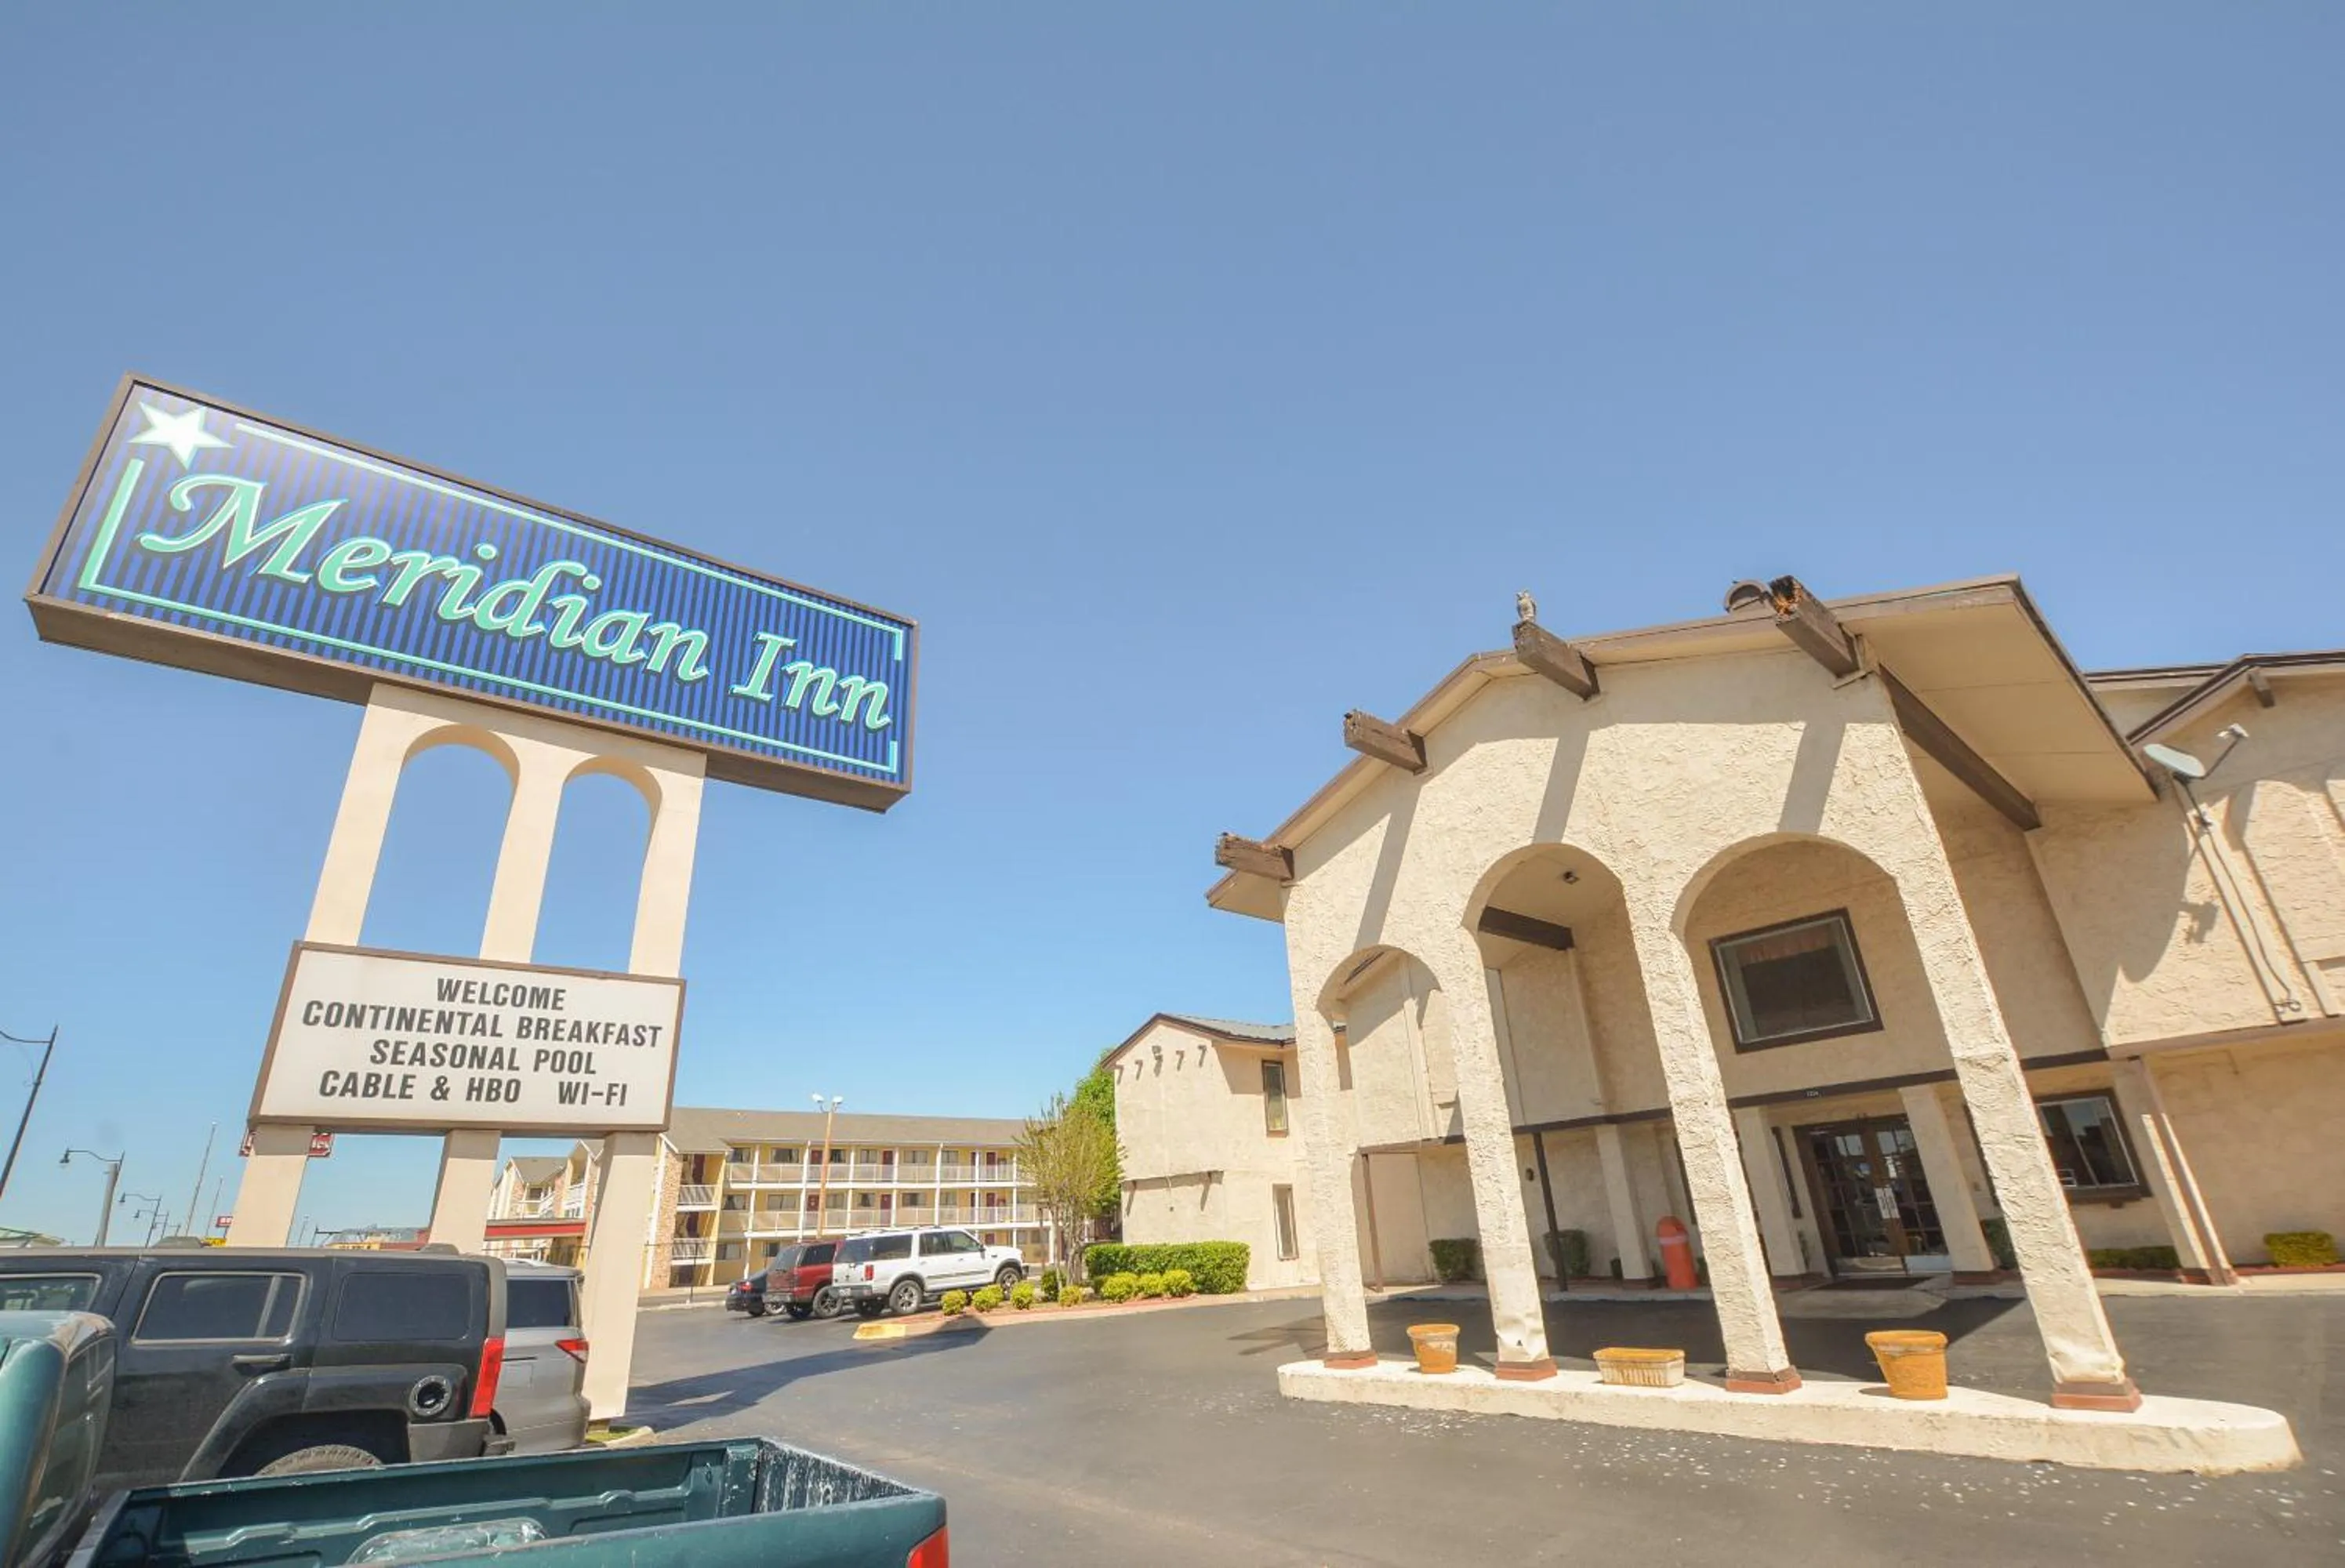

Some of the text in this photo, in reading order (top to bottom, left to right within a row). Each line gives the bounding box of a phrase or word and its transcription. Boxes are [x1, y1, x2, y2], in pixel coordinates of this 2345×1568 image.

[136, 473, 891, 730] Meridian Inn
[437, 978, 565, 1010] WELCOME
[303, 1000, 662, 1047] CONTINENTAL BREAKFAST
[370, 1040, 596, 1074] SEASONAL POOL
[320, 1071, 626, 1105] CABLE & HBO WI-FI
